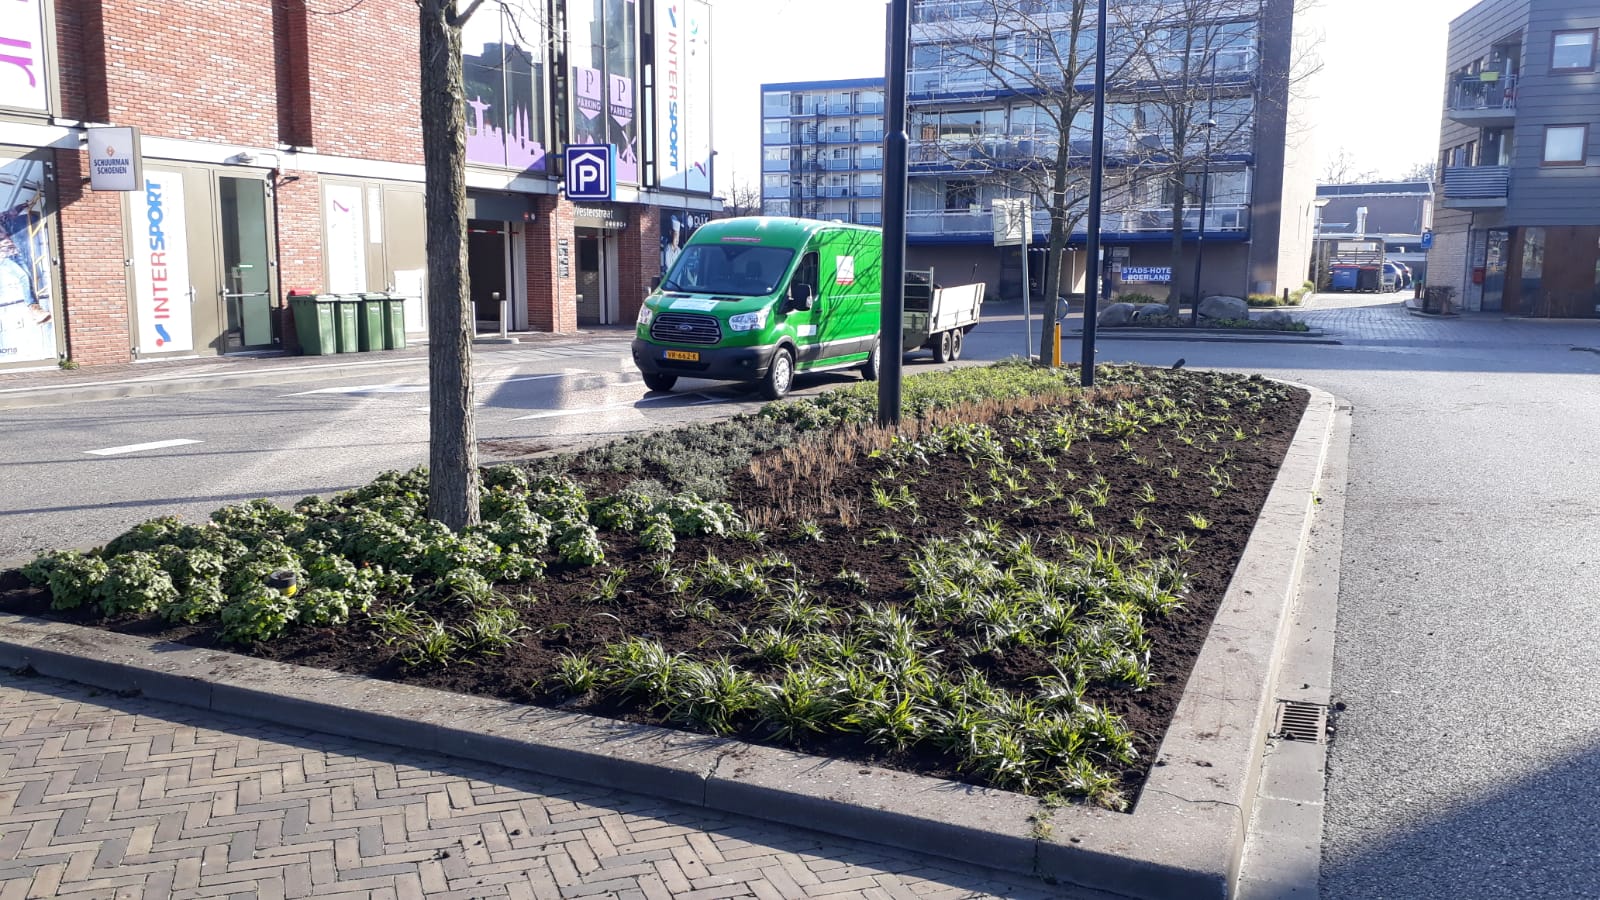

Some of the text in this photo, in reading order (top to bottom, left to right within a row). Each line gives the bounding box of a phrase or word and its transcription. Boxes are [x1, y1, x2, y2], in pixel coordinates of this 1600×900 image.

[585, 70, 594, 93] P
[617, 79, 626, 102] P
[577, 97, 601, 111] PARKING
[668, 32, 678, 172] INTERSPORT
[93, 158, 130, 167] SCHUURMAN
[97, 166, 128, 175] SCHOENEN
[580, 165, 598, 192] P
[145, 179, 170, 319] INTERSPORT
[1424, 233, 1431, 242] P
